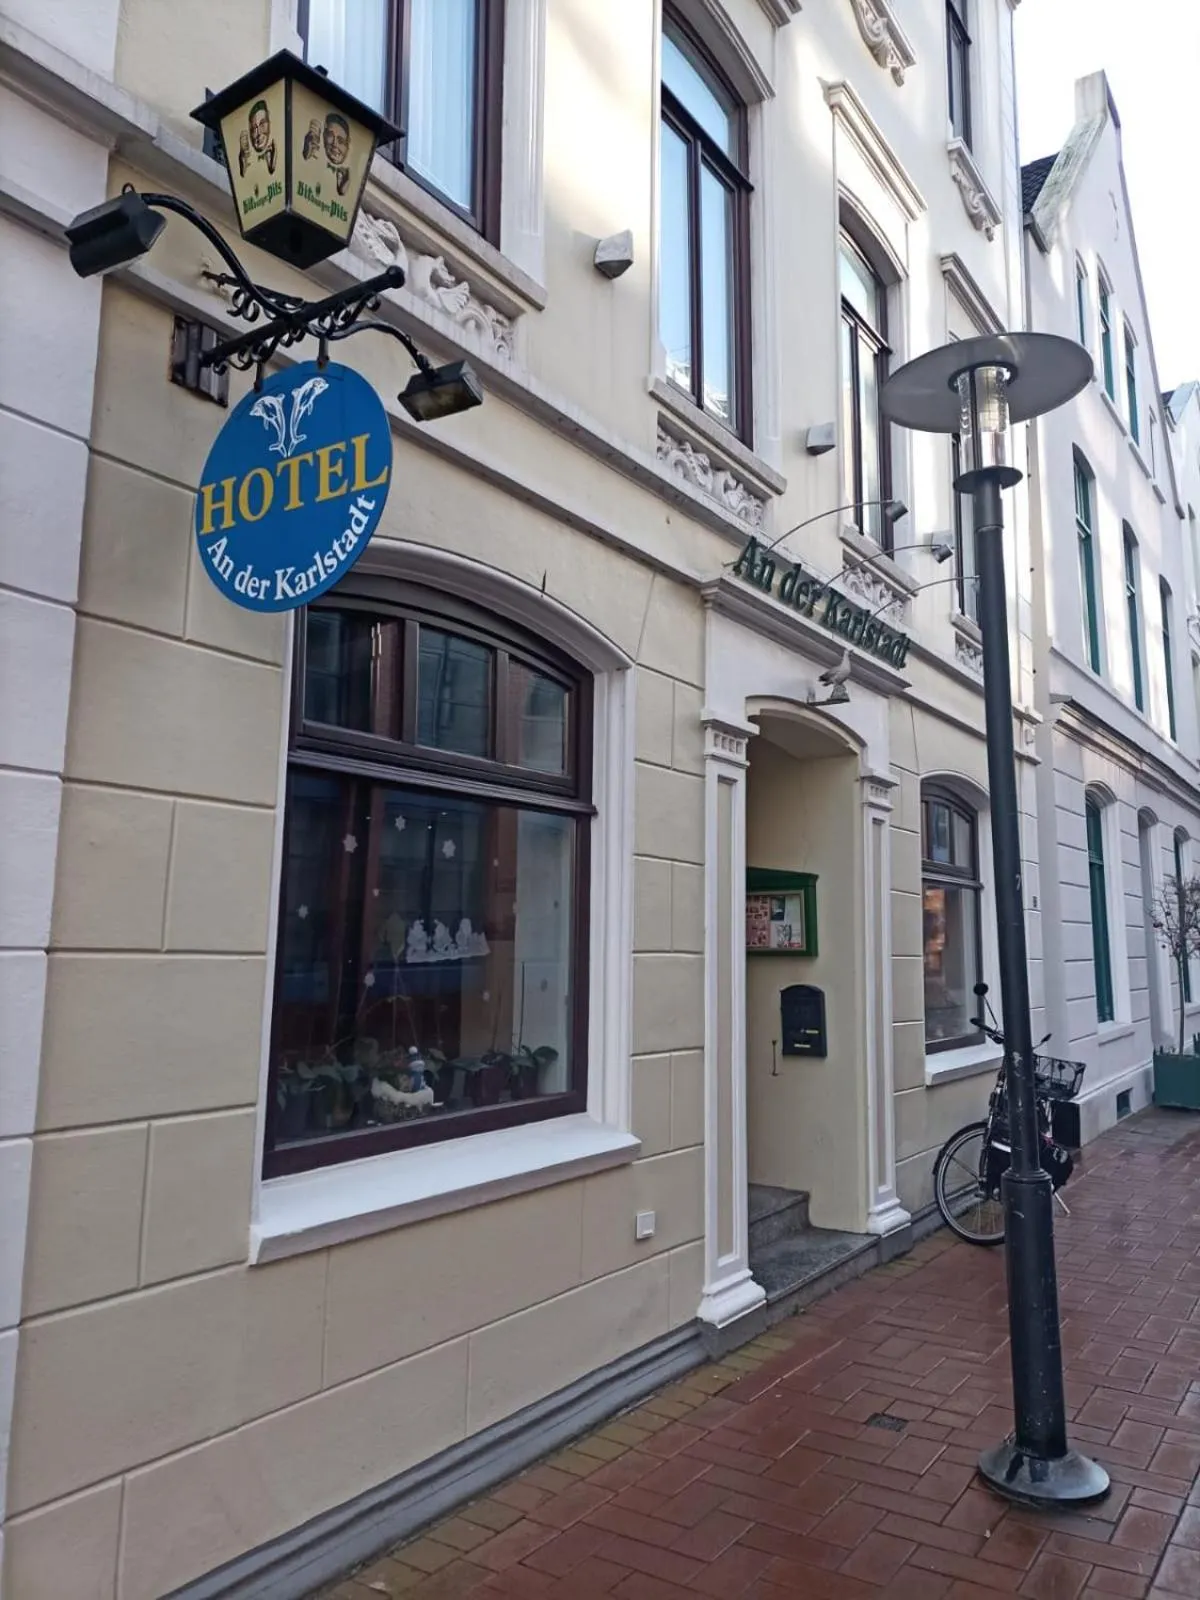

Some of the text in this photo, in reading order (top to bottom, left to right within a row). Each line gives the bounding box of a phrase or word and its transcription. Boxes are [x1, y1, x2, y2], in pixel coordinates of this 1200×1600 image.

[330, 200, 349, 222] Pils
[199, 433, 389, 535] HOTEL
[207, 494, 377, 601] An der Karlstadt
[732, 536, 911, 670] An der Karlstadt
